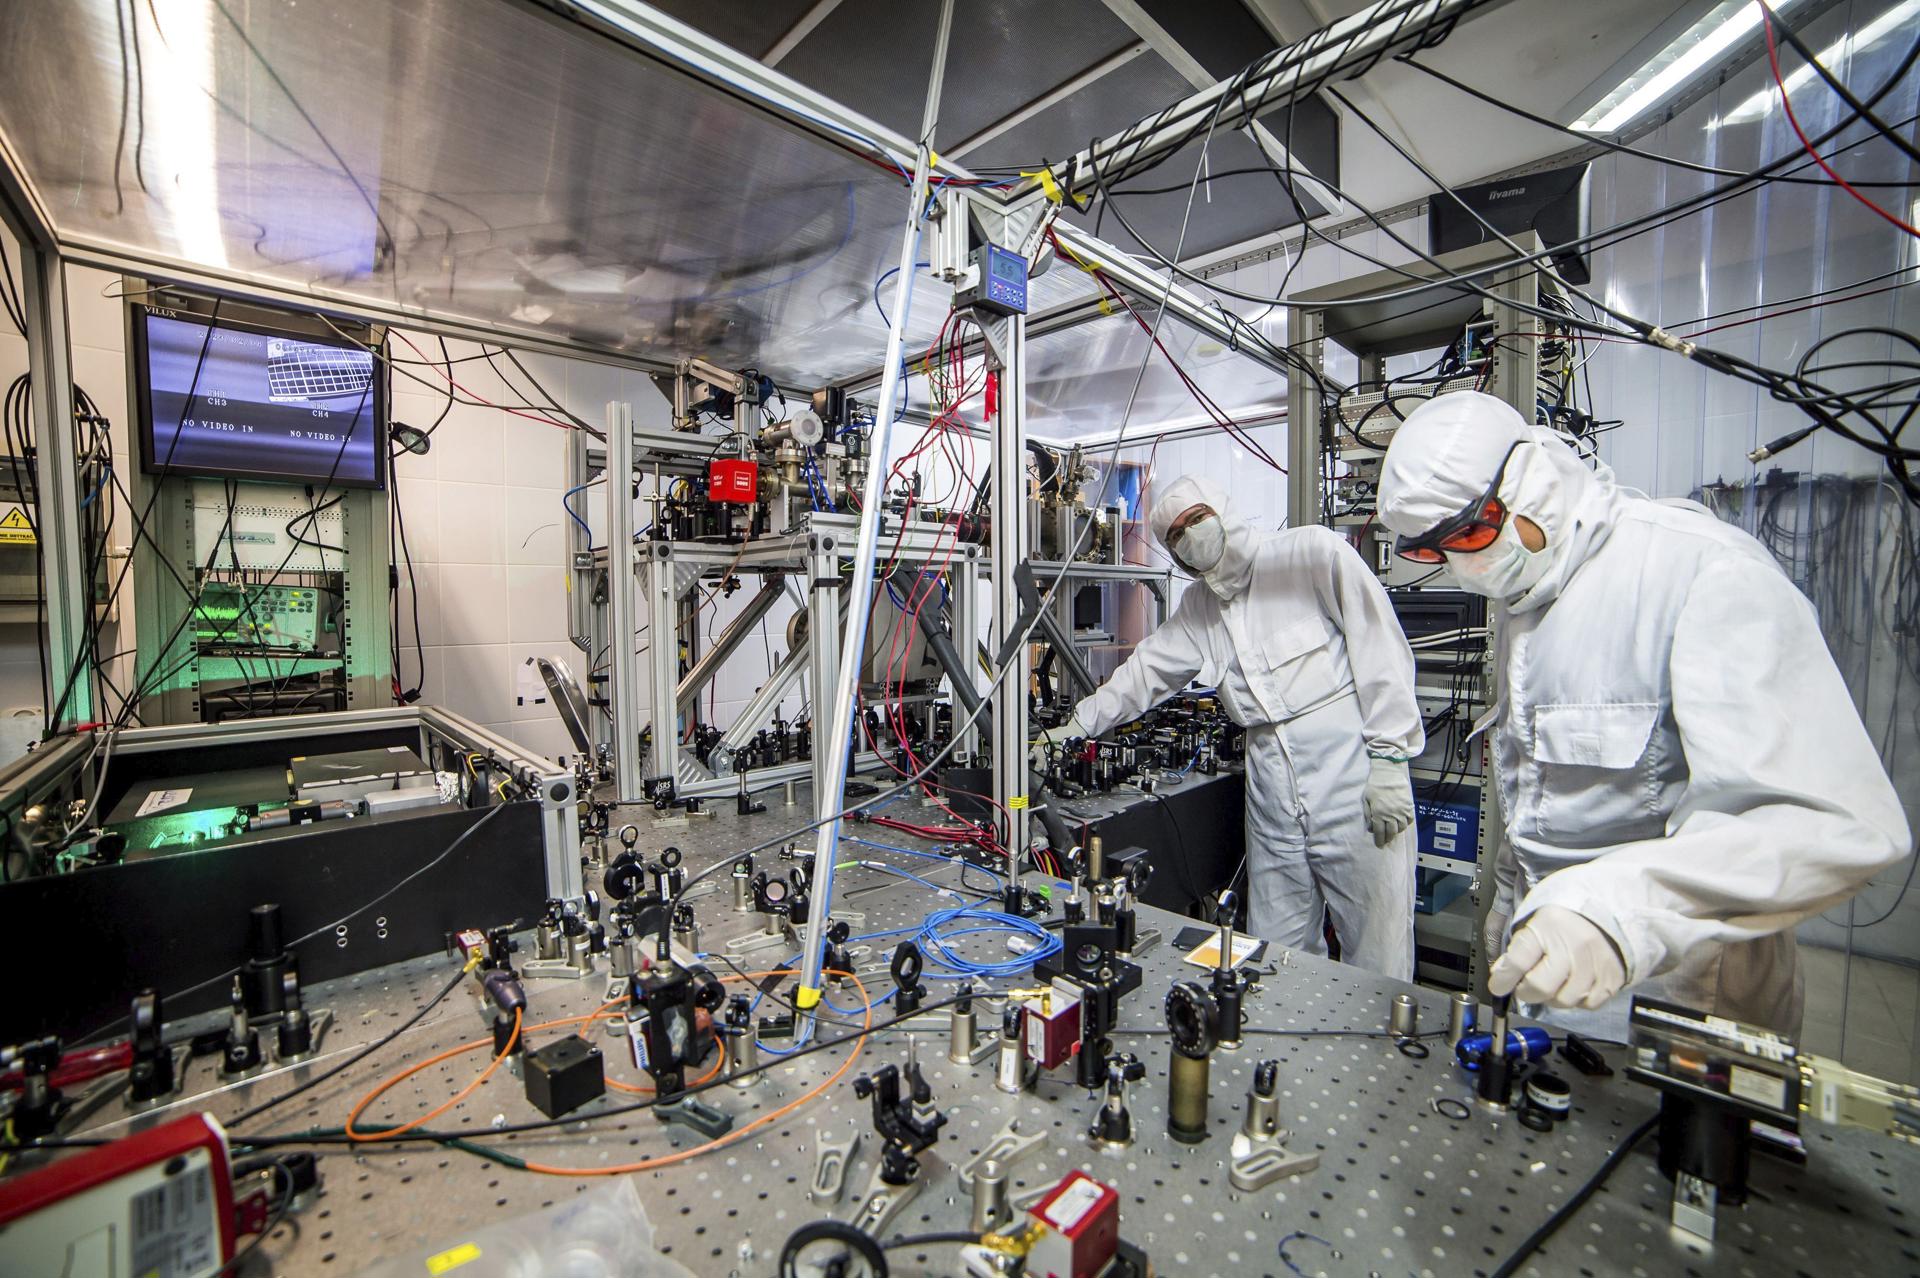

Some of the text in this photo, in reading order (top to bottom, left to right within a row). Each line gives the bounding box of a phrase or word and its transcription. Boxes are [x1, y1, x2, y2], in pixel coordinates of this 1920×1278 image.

[144, 305, 177, 318] VILUX
[207, 397, 227, 407] CH3
[312, 409, 329, 418] CH4
[182, 418, 254, 433] NO VIDEO IN
[290, 430, 302, 438] NO
[307, 432, 335, 441] VIDEO
